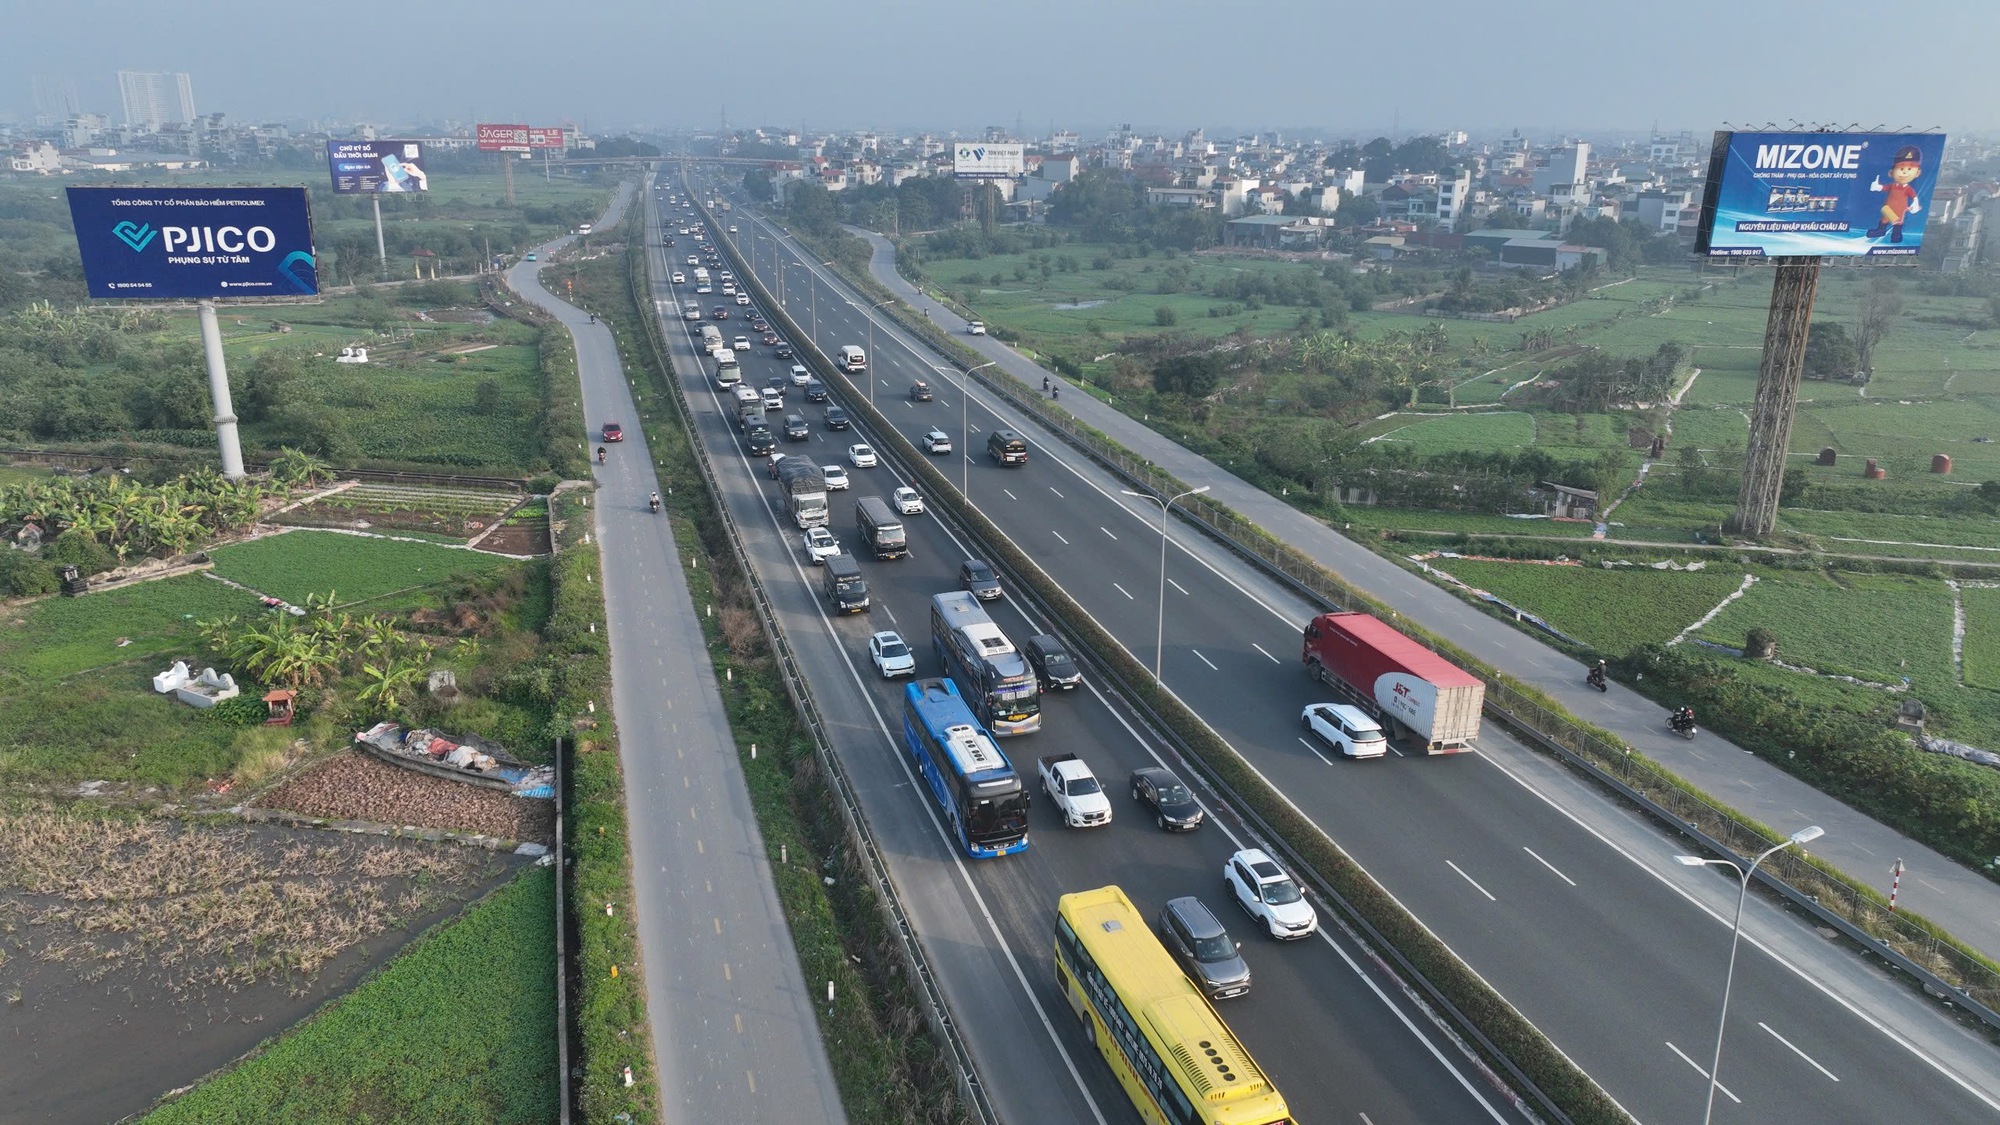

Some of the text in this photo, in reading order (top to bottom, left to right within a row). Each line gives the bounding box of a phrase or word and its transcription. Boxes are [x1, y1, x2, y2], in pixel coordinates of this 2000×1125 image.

[1756, 144, 1862, 169] MIZONE
[164, 198, 174, 206] CỔ
[1739, 221, 1848, 233] NGUYÊN LIỆU NHẬP KHẨU CHÂU ÂU
[162, 226, 276, 252] PJICO
[168, 255, 250, 265] PHỤNG SỰ TỪ TÂM
[1392, 682, 1411, 698] J&T
